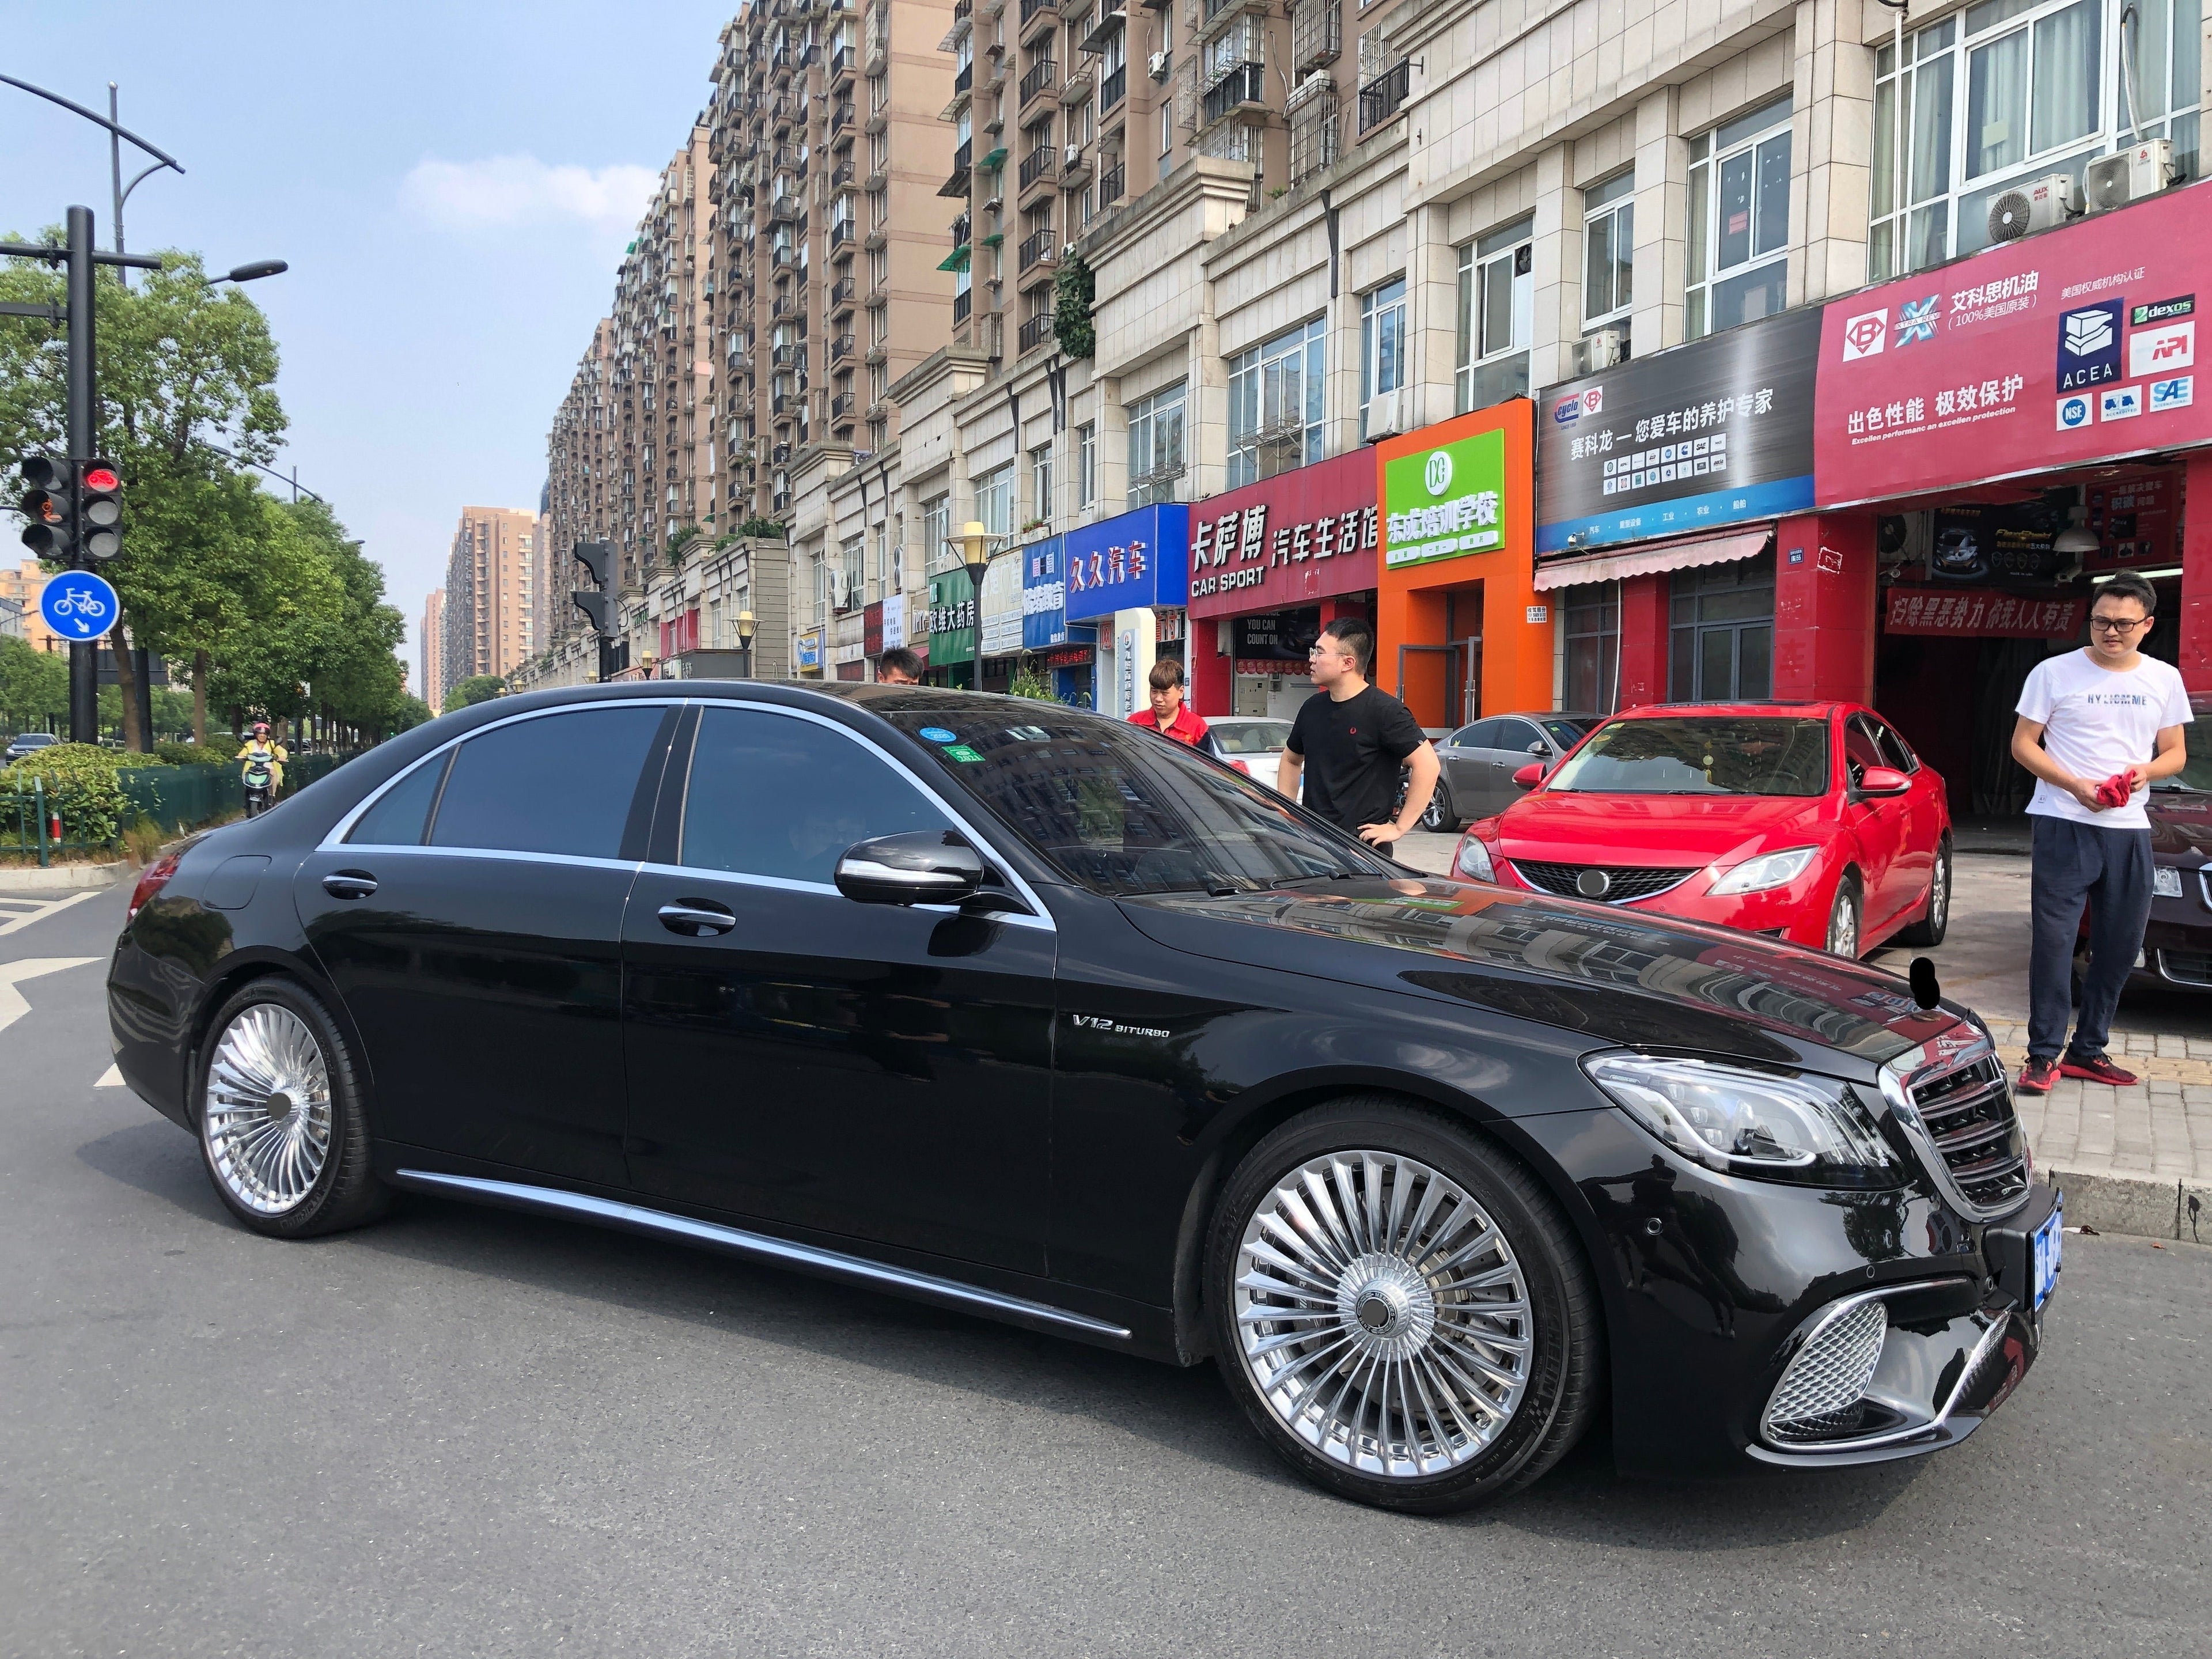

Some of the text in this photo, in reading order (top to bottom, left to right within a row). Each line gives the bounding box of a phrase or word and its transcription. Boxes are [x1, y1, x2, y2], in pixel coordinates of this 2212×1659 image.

[2033, 186, 2048, 195] AUX
[1949, 270, 2039, 314] 艾科思机油
[2061, 267, 2145, 300] 美国权威机构认证
[1897, 313, 1939, 328] XTRA REV
[2149, 301, 2192, 317] dexos
[2153, 335, 2187, 360] API
[2063, 363, 2112, 389] ACEA
[2153, 378, 2188, 402] SAE
[1558, 399, 1578, 417] cyclo
[1847, 373, 2024, 434] 出色性能 极效保护
[2106, 408, 2137, 417] ACCREDITED
[1851, 406, 2016, 445] Excellen performanc an excellen protection
[1387, 491, 1498, 544] 东成培训学校
[1589, 525, 1600, 535] 汽车
[1663, 512, 1675, 521] 工业
[1696, 505, 1710, 514] 农业
[1191, 503, 1378, 573] 卡萨博 汽车生活馆
[1070, 540, 1146, 593] 久久汽车
[1191, 566, 1264, 597] CAR SPORT
[930, 599, 974, 634] 欧维大药房
[1247, 619, 1275, 630] YOU CAN
[1247, 634, 1278, 645] COUNT ON
[1073, 1014, 1170, 1037] V12 BITURBO
[1375, 1292, 1395, 1317] MERCEDES
[1359, 1317, 1371, 1331] BENZ
